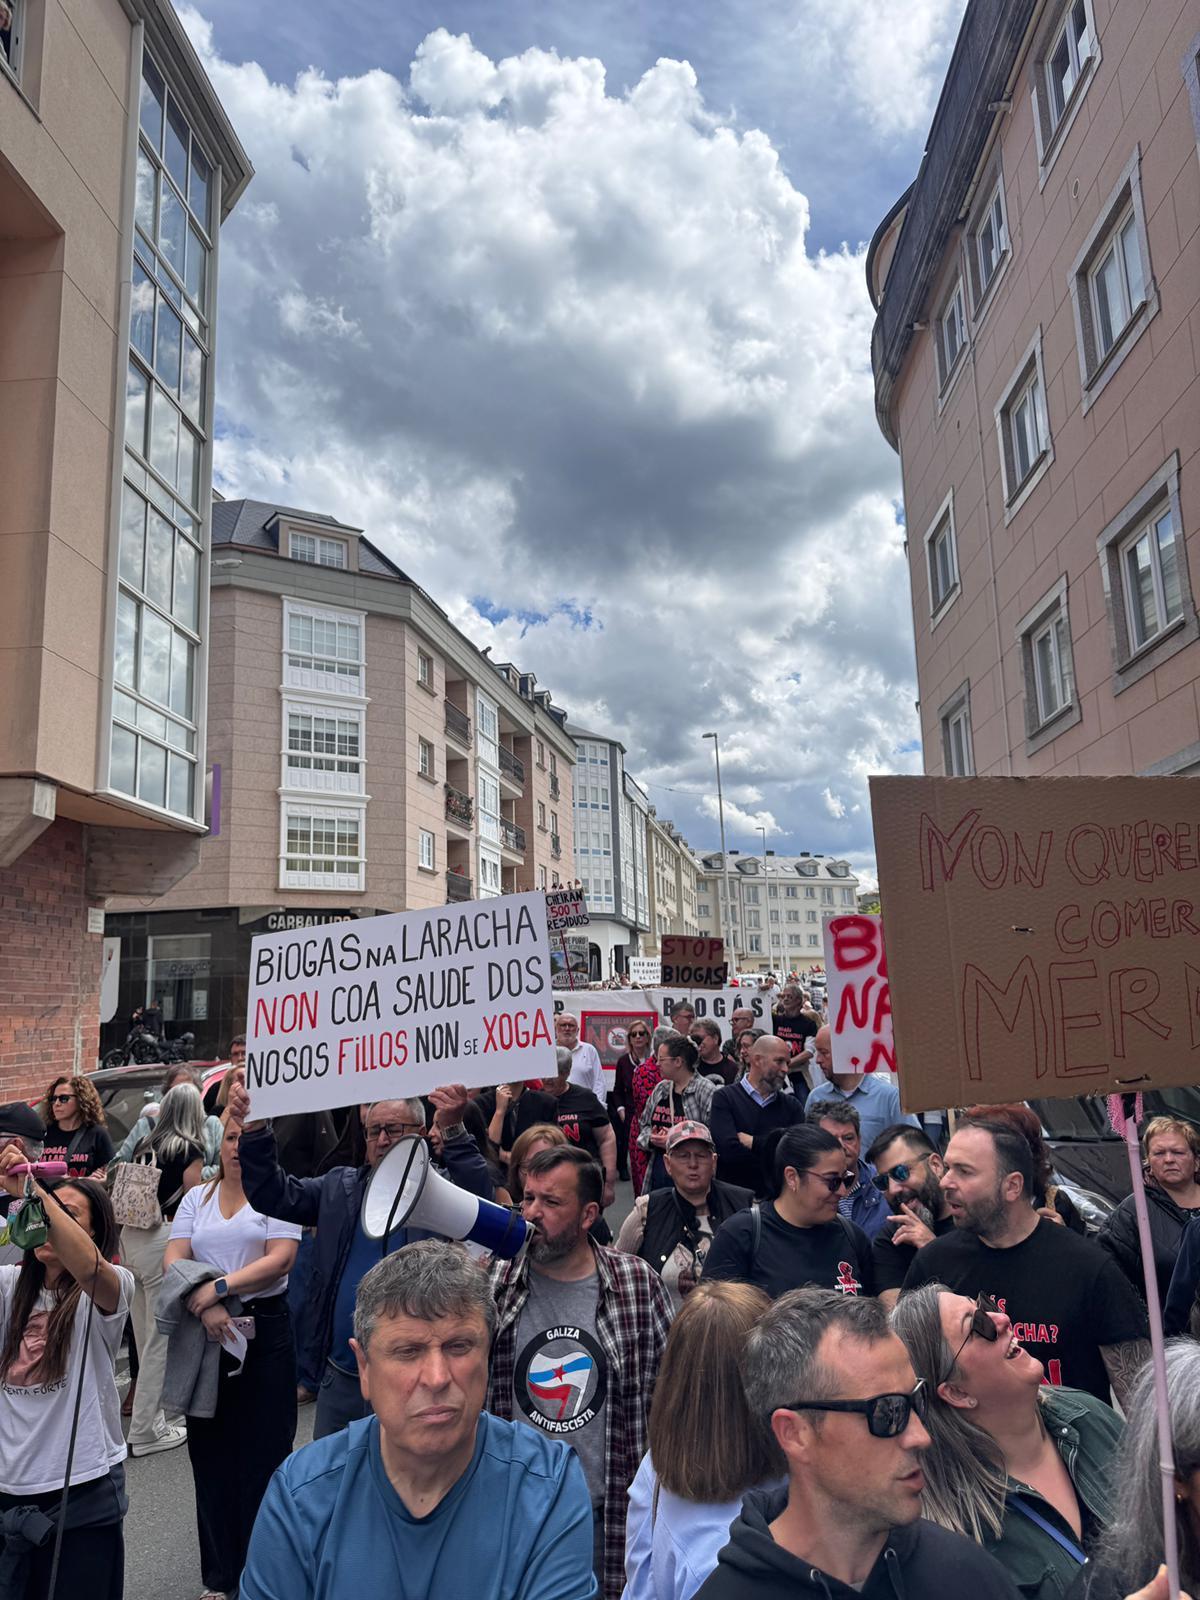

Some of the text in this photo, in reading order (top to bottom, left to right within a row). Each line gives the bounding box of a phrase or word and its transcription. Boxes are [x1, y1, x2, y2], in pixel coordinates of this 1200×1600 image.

[920, 808, 1200, 891] NON QUERE
[366, 945, 397, 969] NA
[401, 905, 538, 963] LARACHA
[1054, 897, 1200, 953] COMER
[662, 938, 723, 960] STOP
[662, 965, 724, 985] BIOGAS
[254, 990, 319, 1038] NON
[331, 980, 381, 1025] COA
[393, 965, 476, 1016] SAUDE
[488, 956, 544, 1002] DOS
[663, 994, 763, 1018] BOGÁS
[246, 1042, 329, 1090] NOSOS
[415, 1020, 459, 1064] NON
[463, 1038, 479, 1056] SE
[482, 1008, 552, 1054] XOGA
[546, 1326, 580, 1341] GALIZA
[529, 1408, 596, 1433] ANTIFASCISTA
